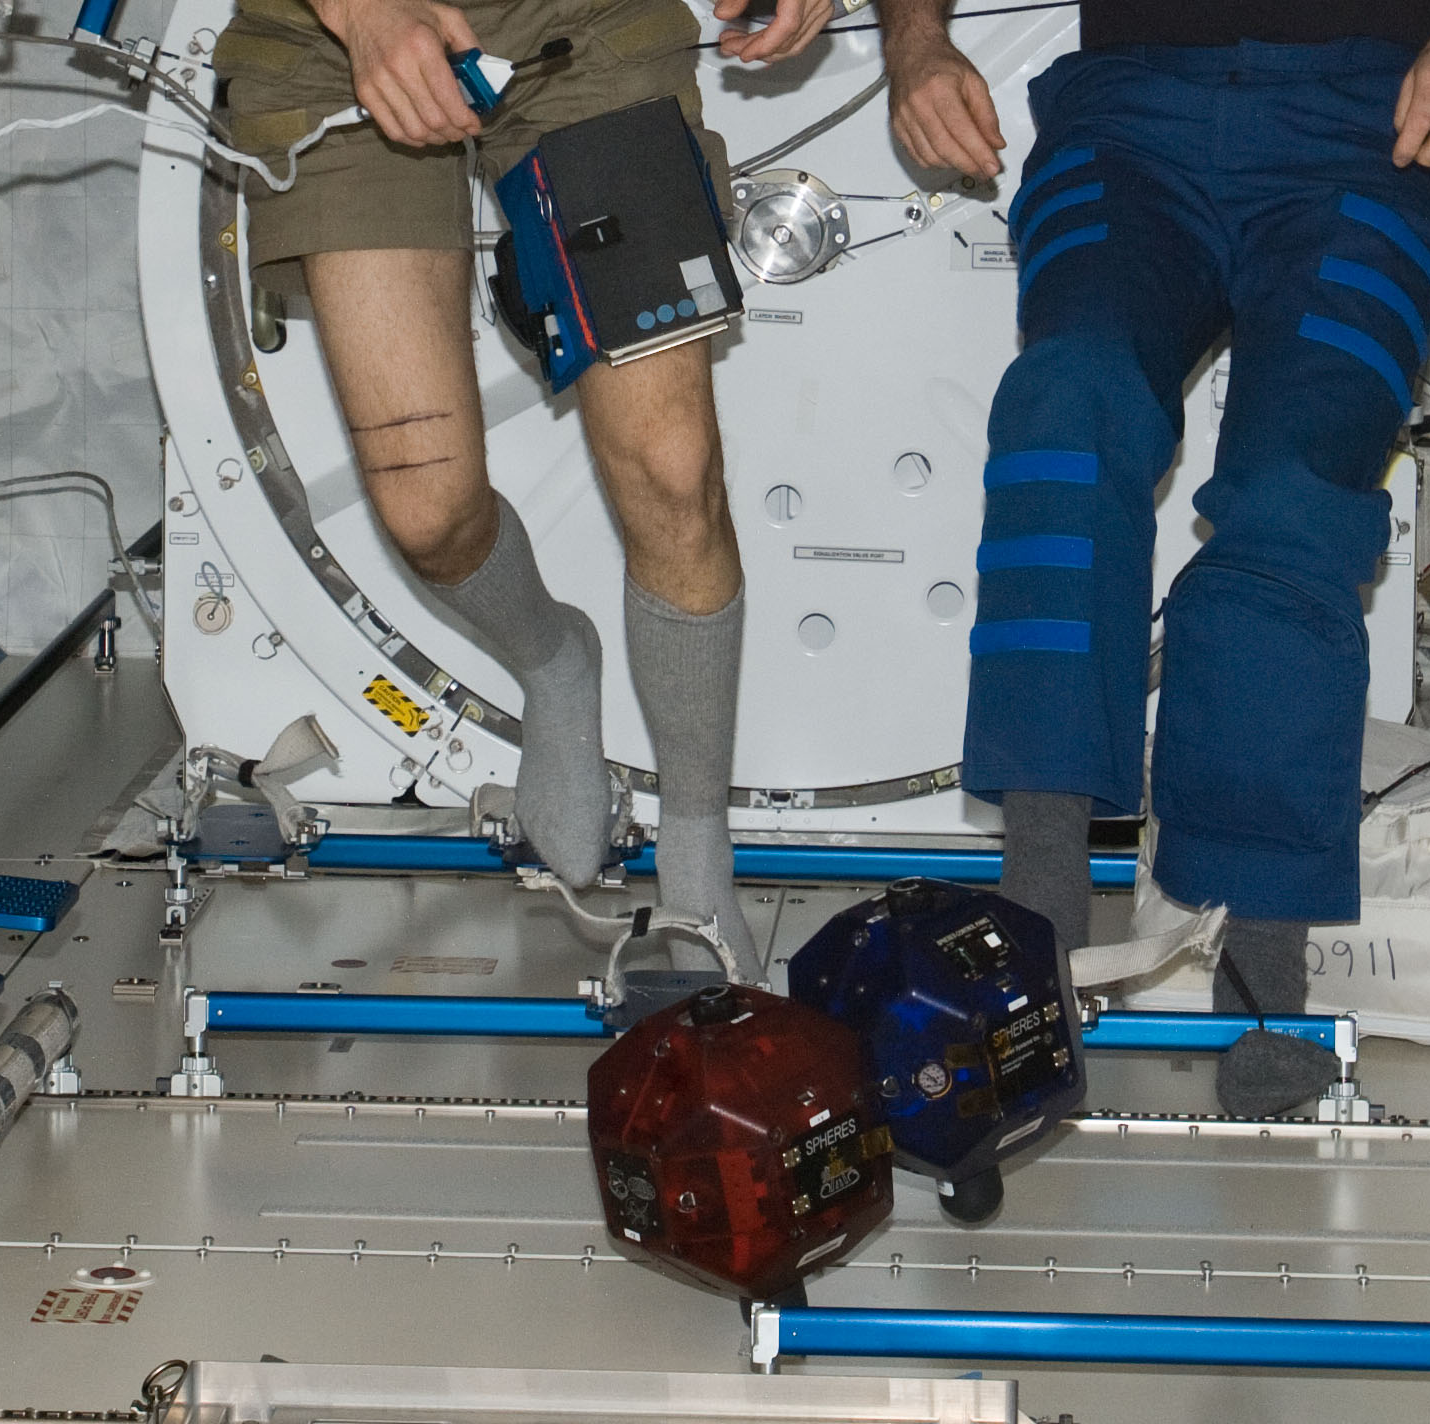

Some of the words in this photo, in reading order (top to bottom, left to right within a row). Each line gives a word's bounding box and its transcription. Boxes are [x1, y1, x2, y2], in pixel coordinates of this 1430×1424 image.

[377, 684, 402, 704] CAUTION
[991, 1011, 1040, 1046] SPHERES
[805, 1118, 856, 1156] SPHERES
